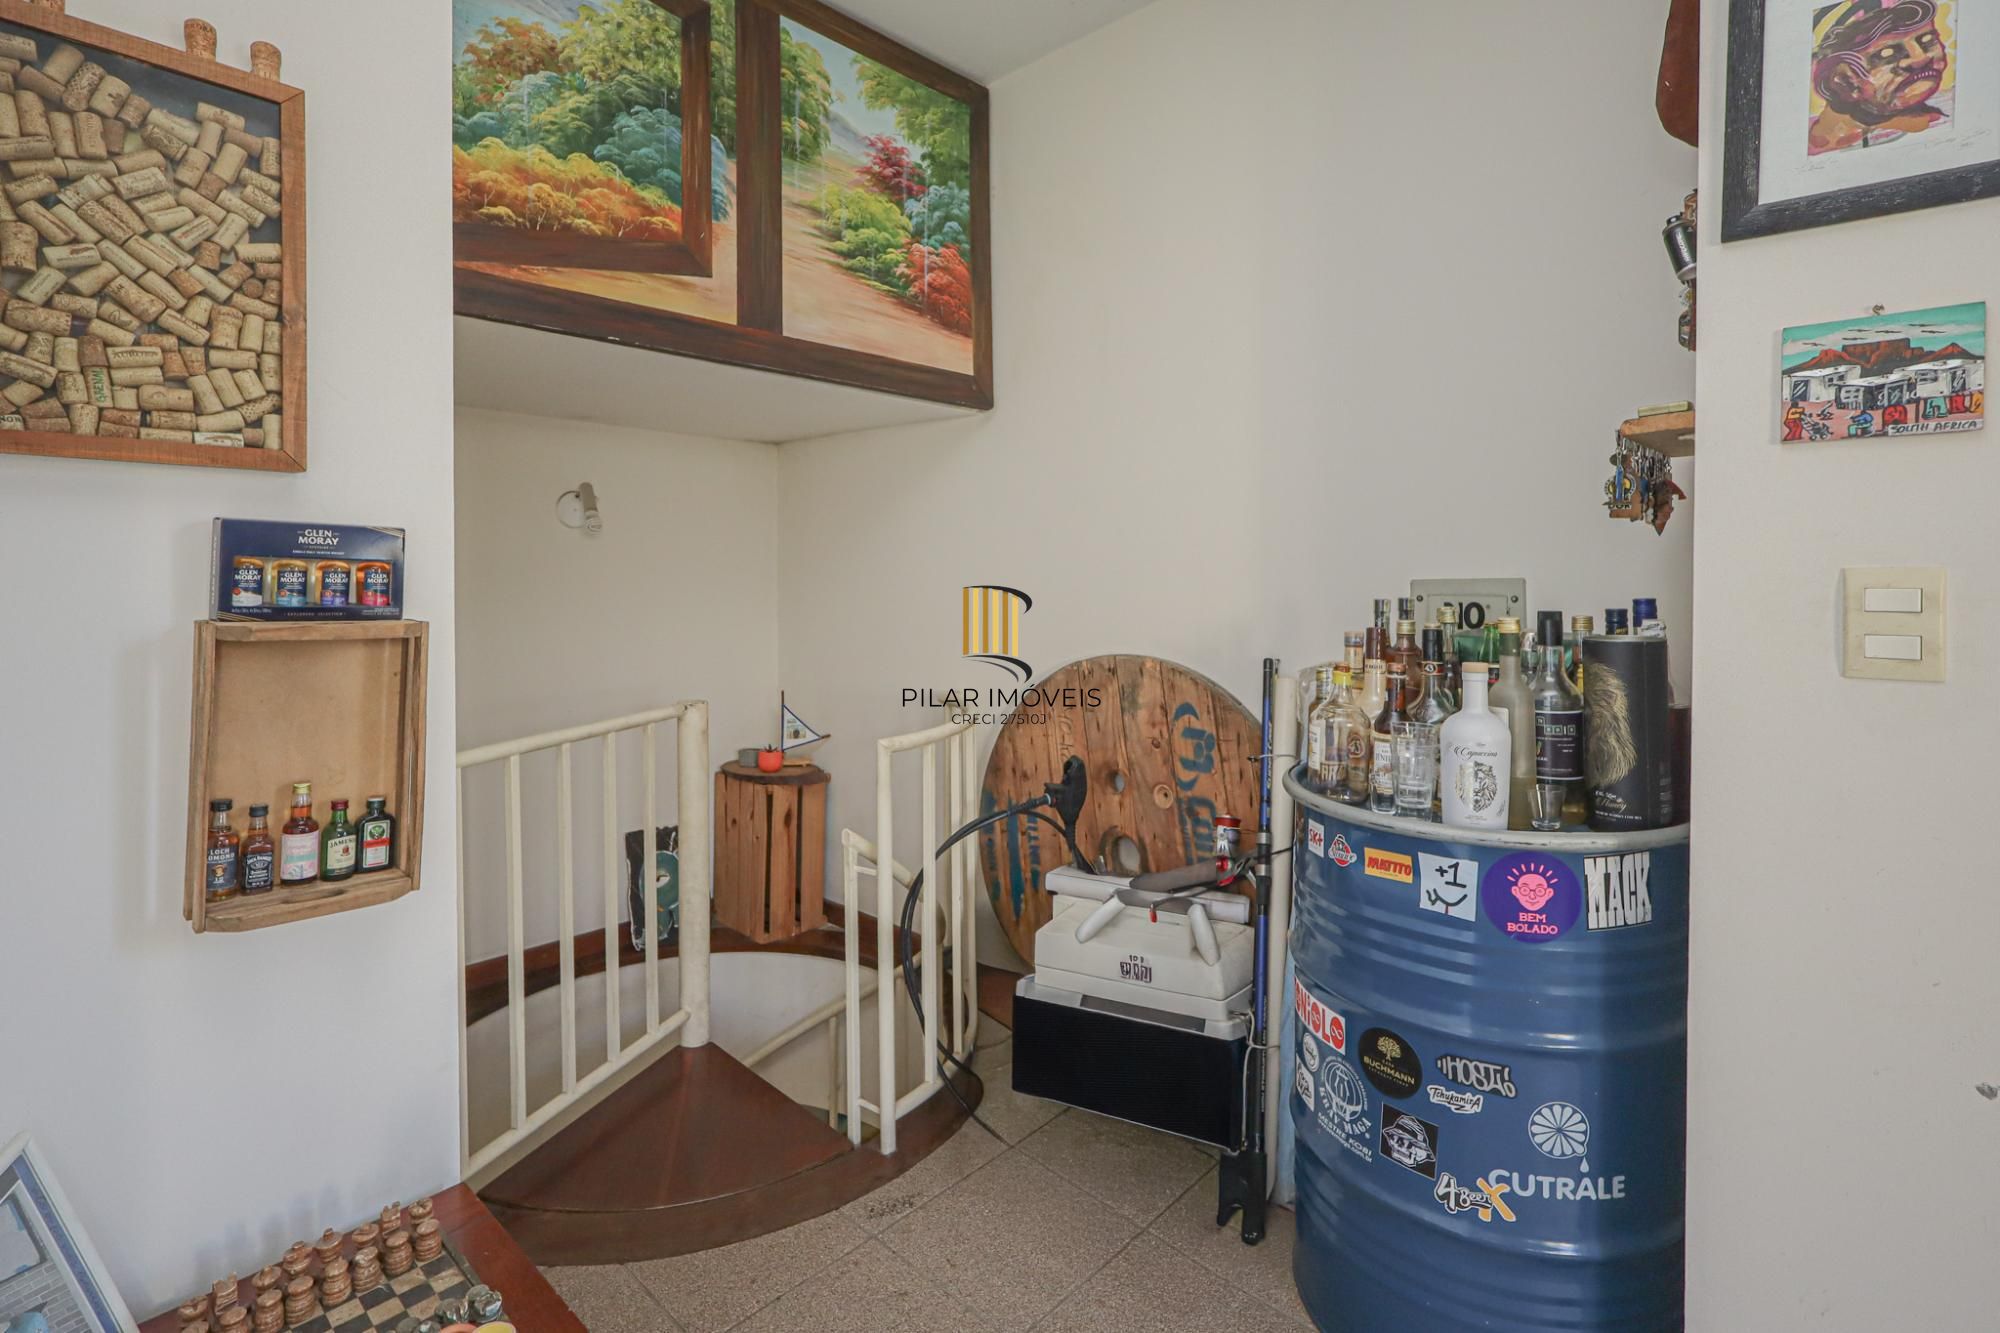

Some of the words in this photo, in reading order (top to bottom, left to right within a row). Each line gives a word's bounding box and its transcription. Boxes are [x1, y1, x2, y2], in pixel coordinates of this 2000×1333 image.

[304, 528, 332, 538] GLEN
[297, 535, 340, 546] MORAY
[206, 852, 236, 862] OMOND
[209, 847, 231, 856] LOCH
[1583, 851, 1652, 930] MACK
[1518, 912, 1546, 923] BEM
[1506, 921, 1558, 935] BOLADO
[1363, 1055, 1416, 1086] BUCHMANN
[1488, 1168, 1626, 1201] CUTRALE
